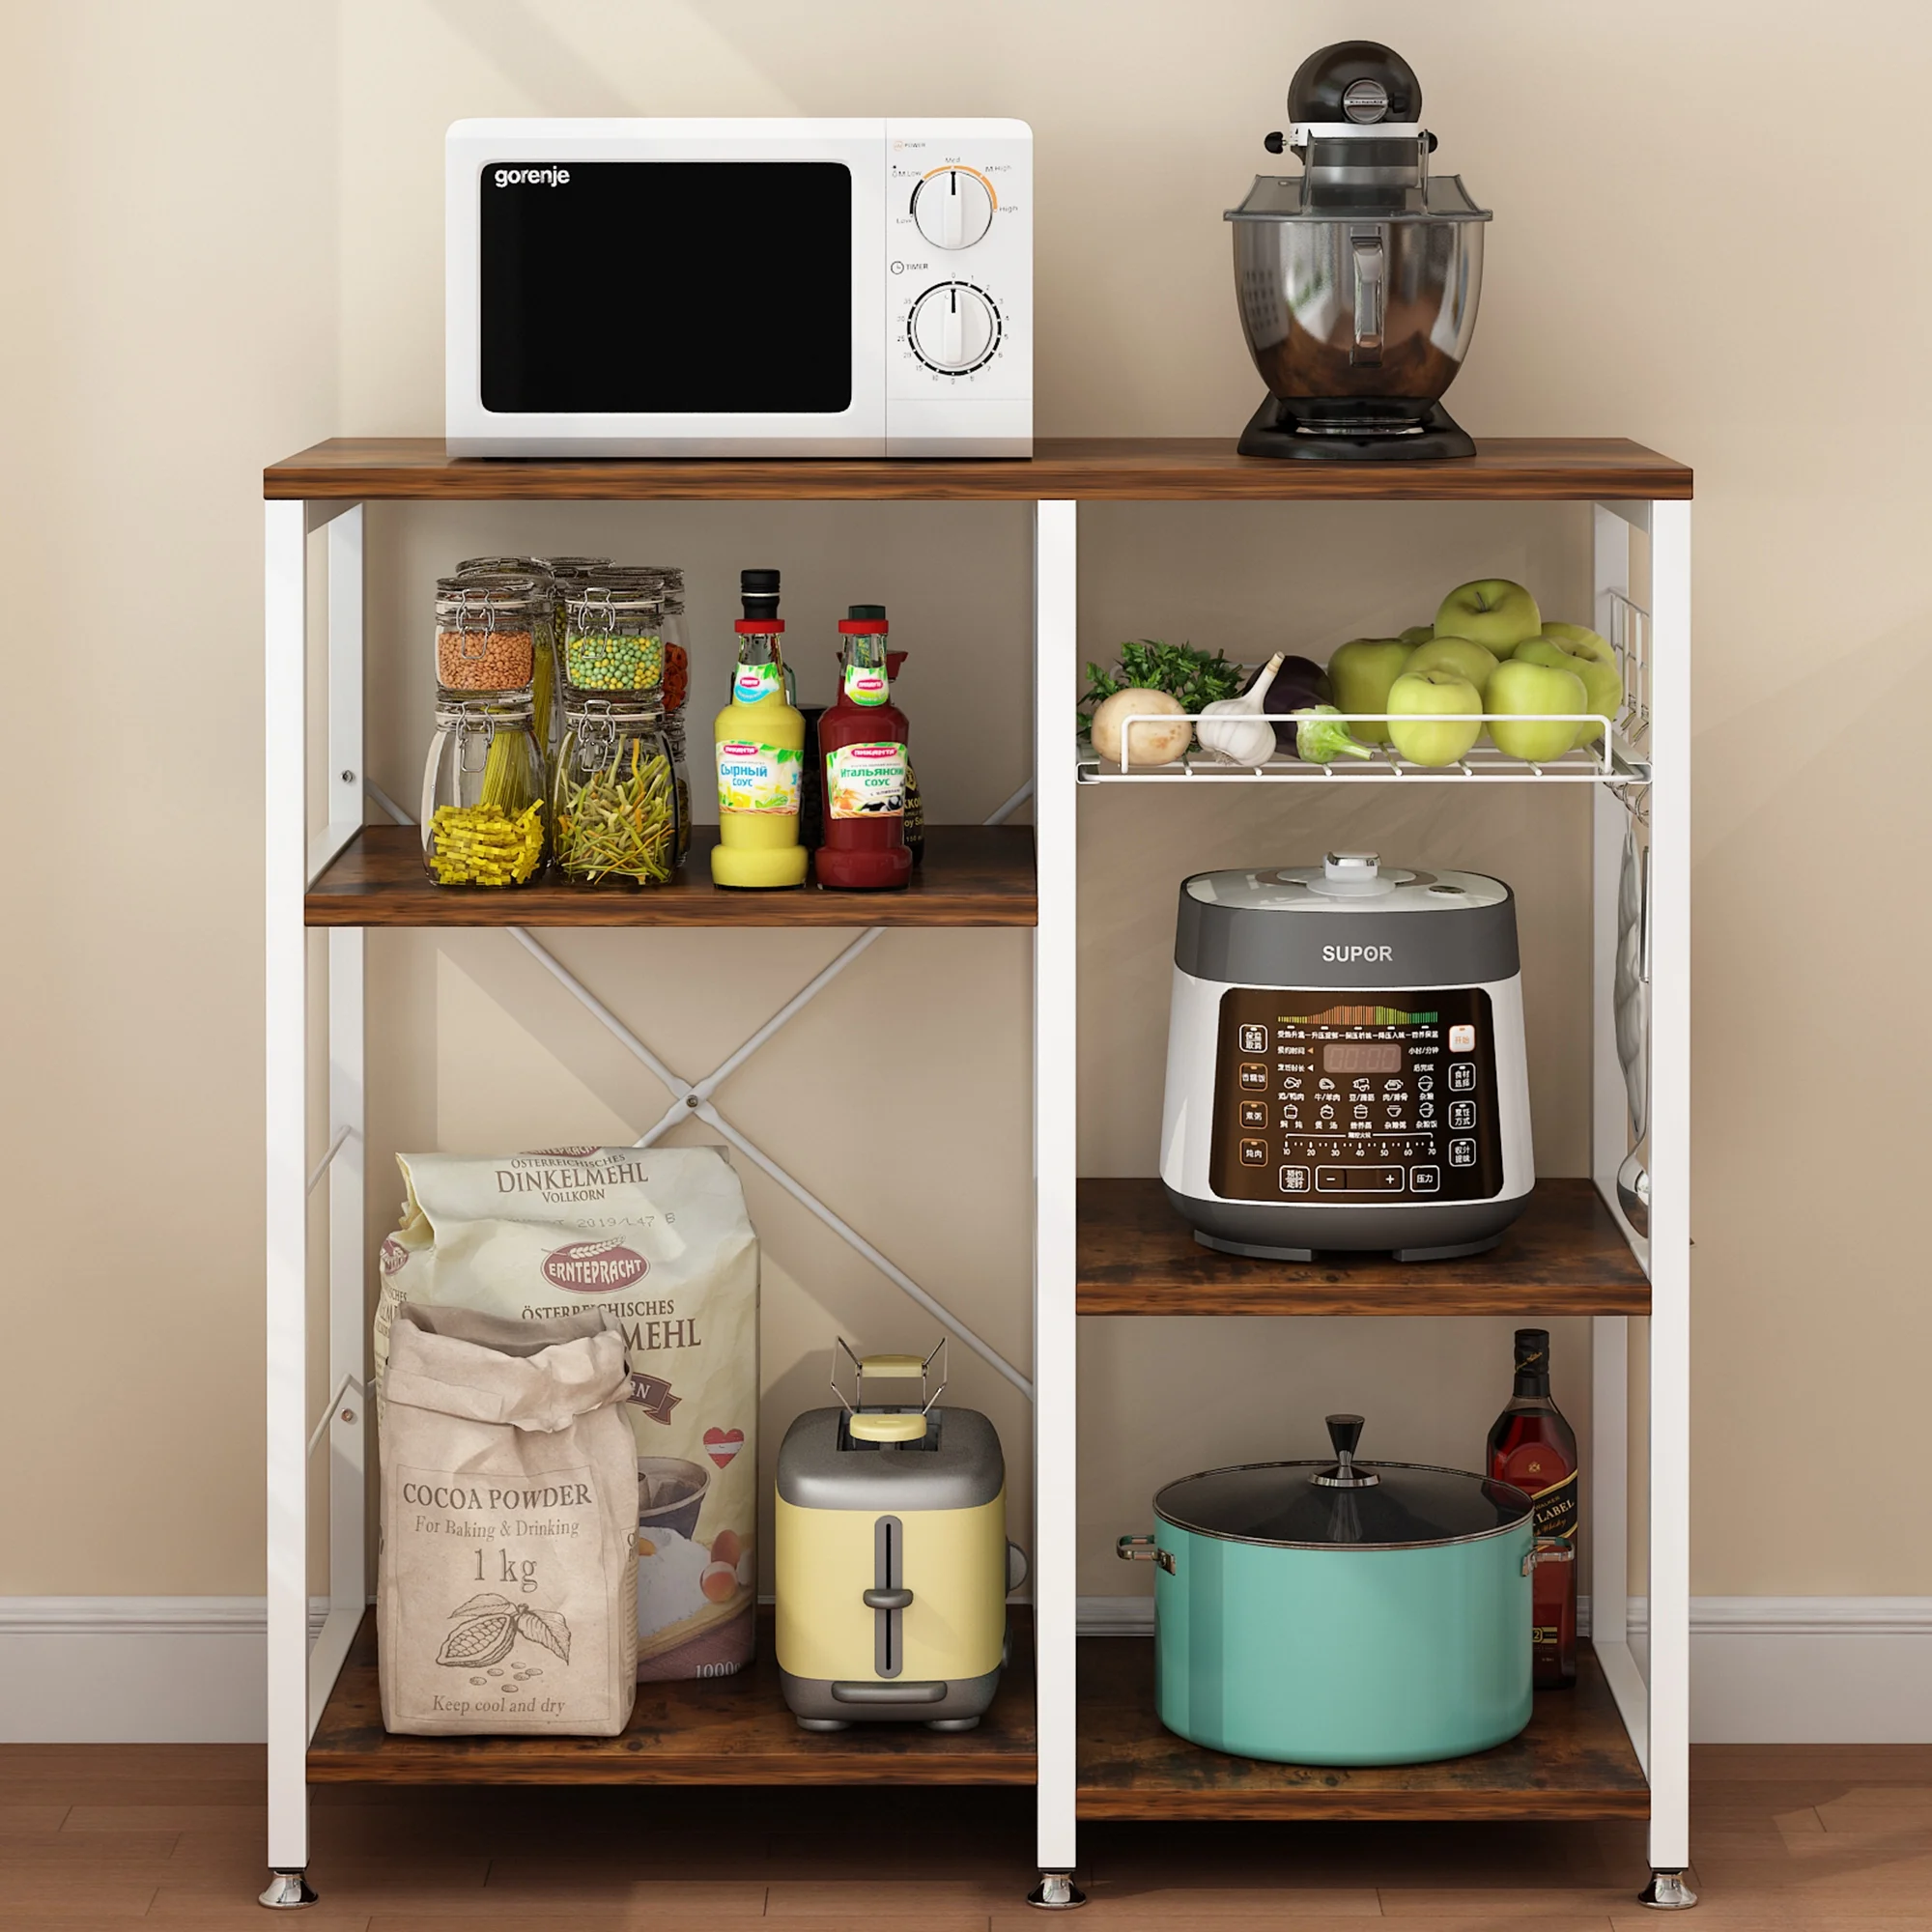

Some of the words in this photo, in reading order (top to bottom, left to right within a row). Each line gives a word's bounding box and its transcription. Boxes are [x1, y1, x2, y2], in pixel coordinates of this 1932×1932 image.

[495, 165, 570, 188] gorenje
[721, 764, 767, 777] Сырный
[1322, 946, 1393, 962] SUPOR
[495, 1162, 648, 1193] DINKELMEHL
[1417, 1174, 1433, 1183] 压力
[542, 1189, 606, 1203] VOLLKORN
[549, 1259, 641, 1284] ERNTEPRACHT
[403, 1483, 483, 1510] COCOA
[489, 1483, 592, 1510] POWDER
[1536, 1499, 1575, 1523] LABEL
[415, 1515, 440, 1533] For
[445, 1520, 496, 1542] Baking
[500, 1520, 510, 1537] &
[516, 1519, 580, 1539] Drinking
[474, 1548, 485, 1581] 1
[498, 1548, 538, 1593] kg
[433, 1695, 470, 1716] Keep
[475, 1697, 505, 1712] cool
[509, 1697, 536, 1712] and
[541, 1697, 565, 1717] dry
